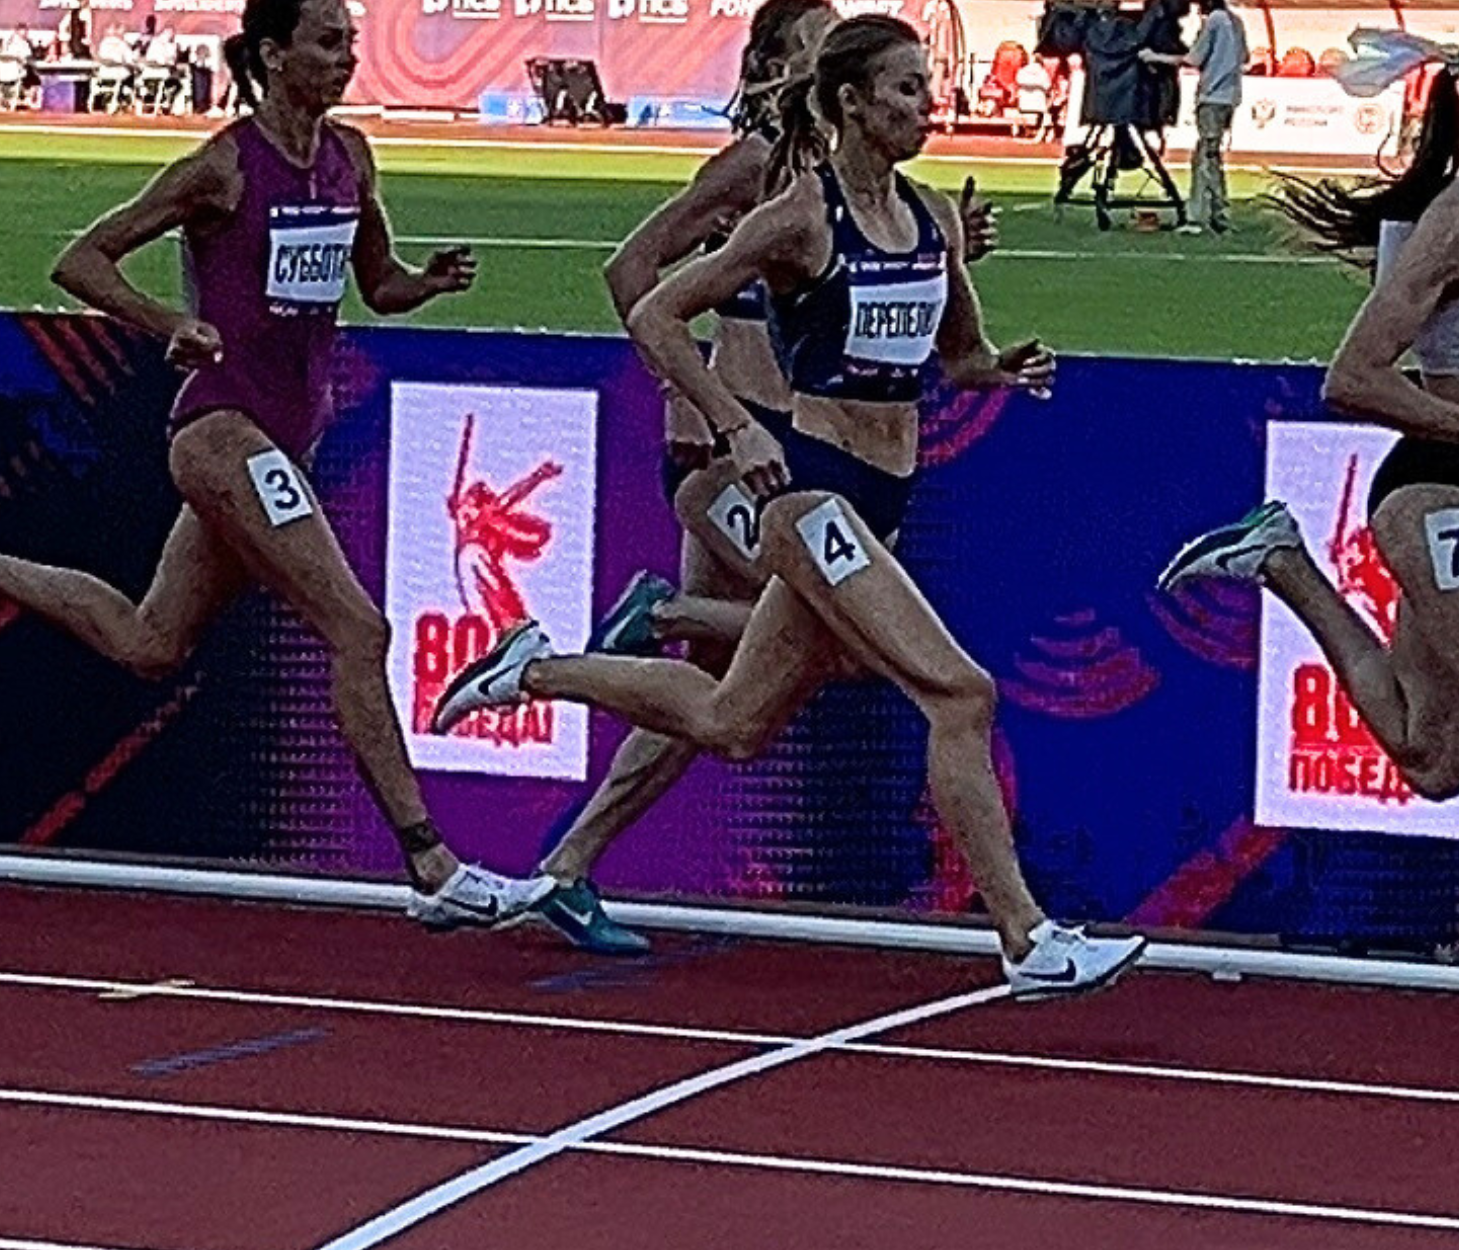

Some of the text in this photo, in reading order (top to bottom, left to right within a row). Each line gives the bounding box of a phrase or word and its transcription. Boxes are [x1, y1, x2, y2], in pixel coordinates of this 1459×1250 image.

[274, 242, 349, 284] СУББОТ
[264, 468, 300, 510] 3
[726, 503, 760, 549] 2
[823, 520, 856, 566] 4
[413, 613, 490, 683] 80
